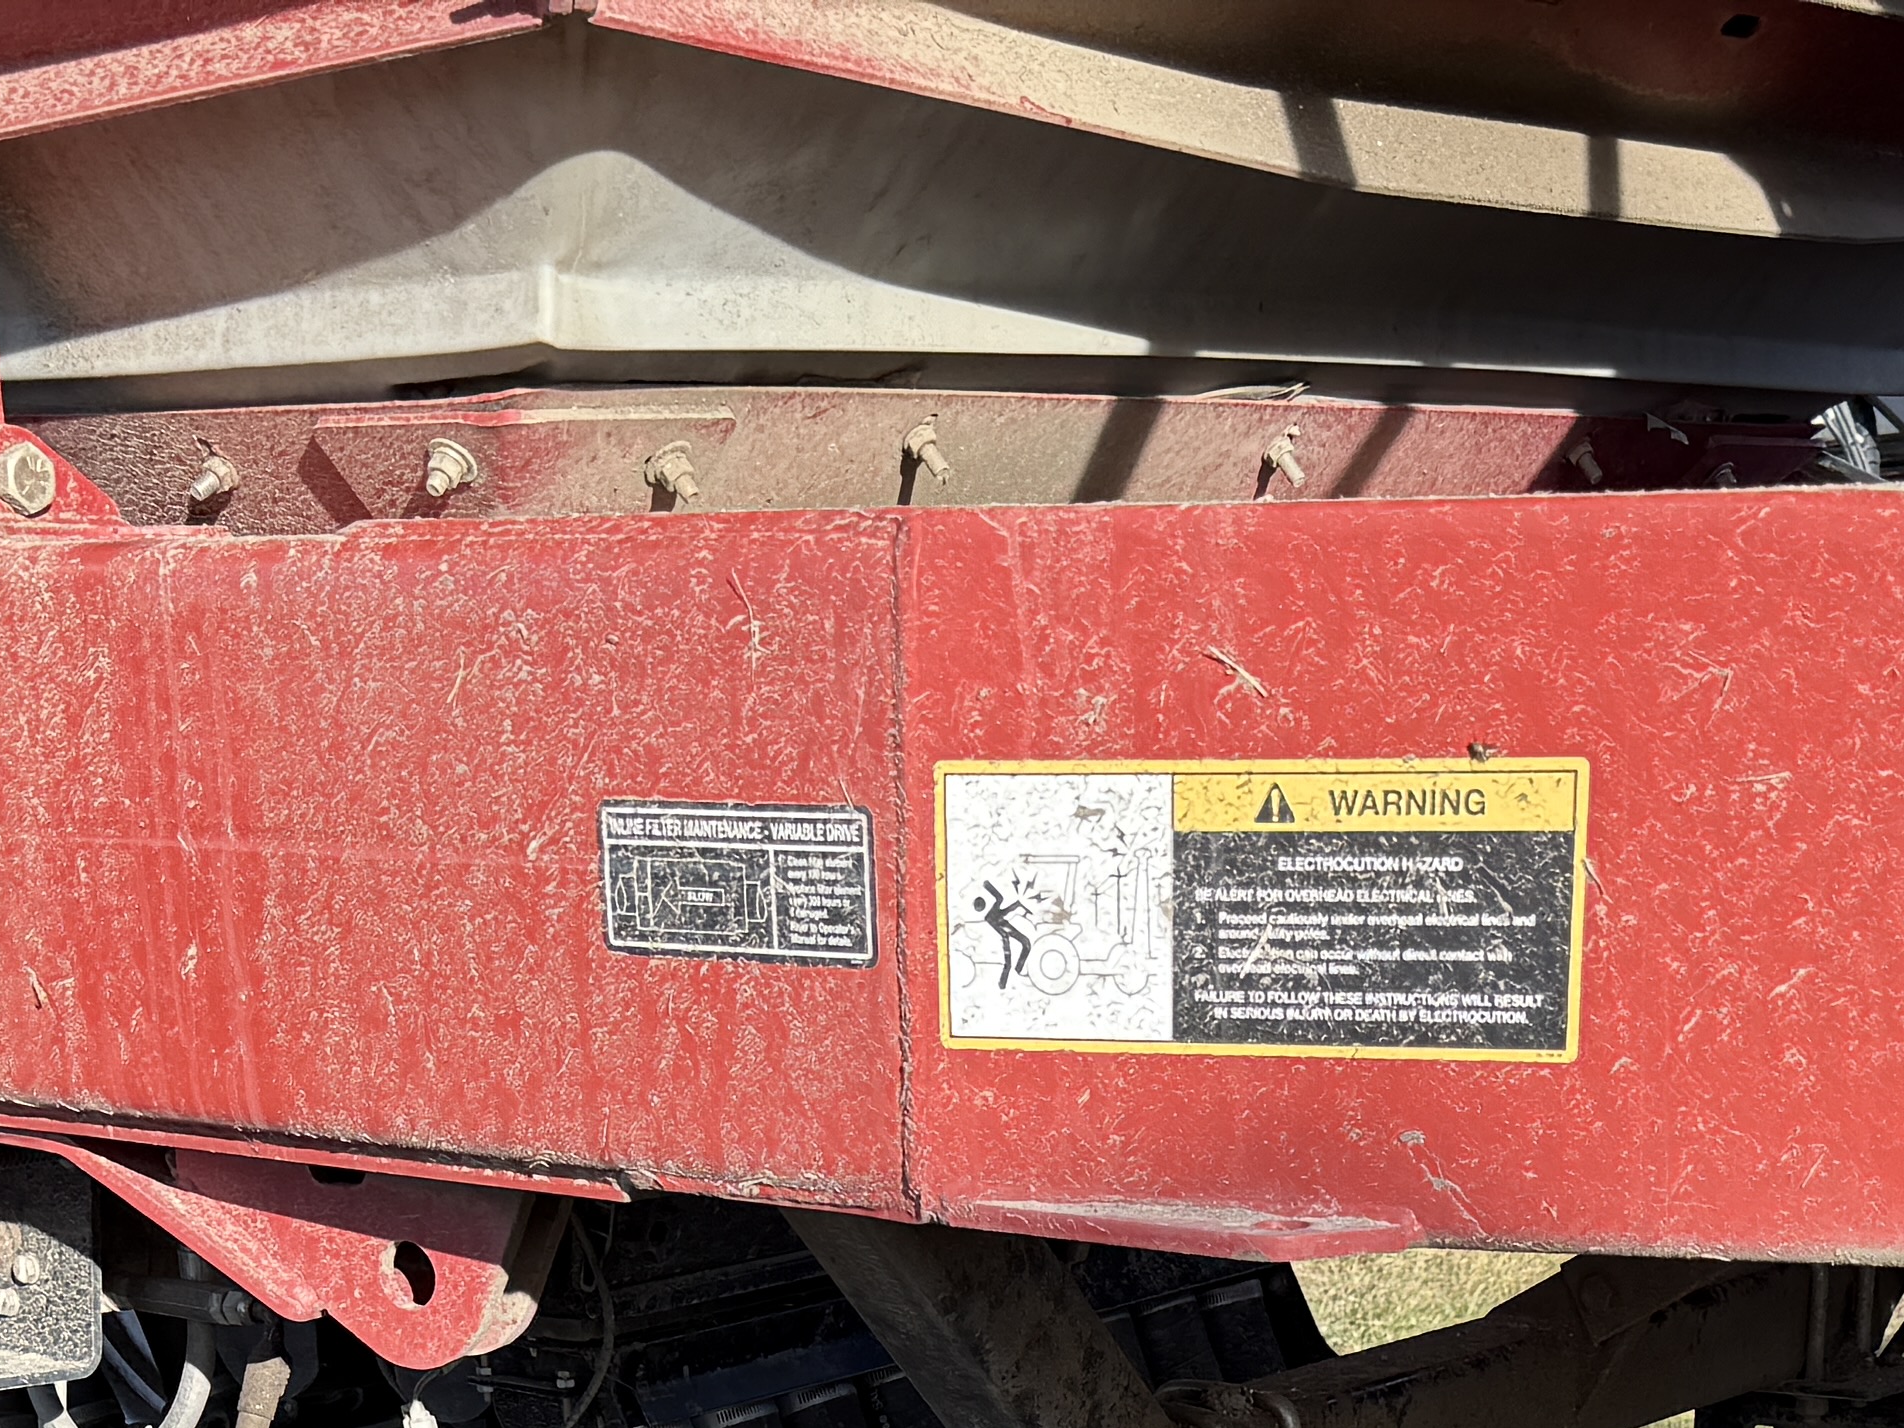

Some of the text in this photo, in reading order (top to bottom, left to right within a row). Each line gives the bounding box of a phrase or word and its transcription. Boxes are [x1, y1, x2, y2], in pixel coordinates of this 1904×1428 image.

[1328, 788, 1487, 817] WARNING
[645, 818, 683, 837] FILTER
[683, 819, 764, 841] MAINTENANCE
[770, 822, 825, 842] VARIABLE
[825, 823, 860, 842] DRIVE
[1277, 856, 1399, 872] ELECTROCUTION
[1214, 888, 1255, 902] ALERT
[1256, 888, 1284, 903] FOR
[1284, 888, 1355, 902] OVERHEAD
[1356, 889, 1434, 903] ELECTRICAL
[1218, 911, 1268, 925] Proceed
[1269, 911, 1329, 928] cautiously
[1330, 913, 1366, 926] under
[1366, 912, 1423, 927] overhead
[1424, 912, 1480, 927] electrical
[1511, 913, 1537, 927] and
[1294, 929, 1331, 942] poles.
[1296, 948, 1318, 961] can
[1319, 948, 1354, 960] occur
[1356, 947, 1400, 961] without
[1401, 949, 1437, 962] direct
[1439, 949, 1485, 962] contact
[1272, 961, 1327, 975] electrical
[1194, 990, 1545, 1008] FAILURE TO FOLLOW THESE INSTRUCTIONS WILL RESULT
[1214, 1006, 1530, 1025] IN SERIOUS INJURY OR DEATH BY ELECTROCUTION.
